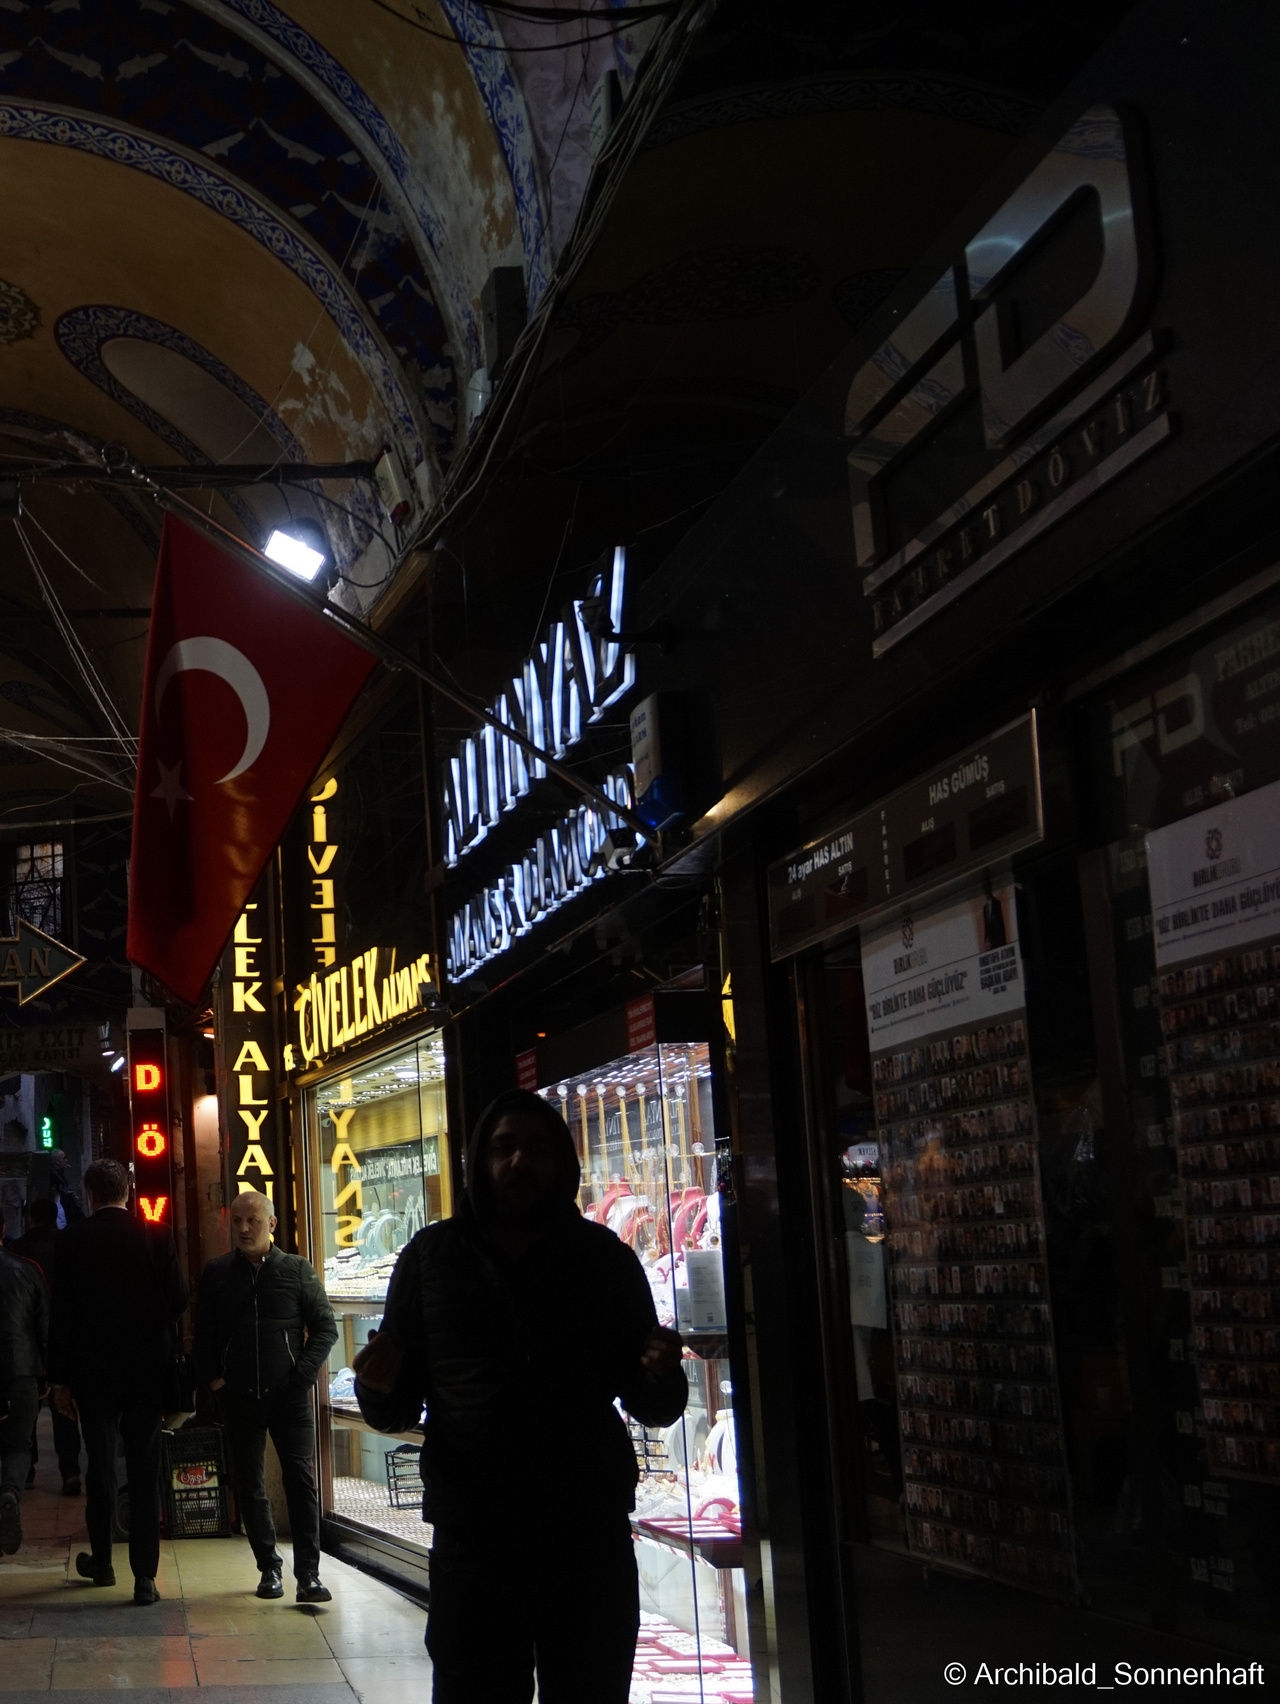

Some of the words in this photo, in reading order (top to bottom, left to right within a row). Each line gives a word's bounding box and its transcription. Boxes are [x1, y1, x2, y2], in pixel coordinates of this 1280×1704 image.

[872, 504, 1000, 631] FAHRET
[1016, 370, 1161, 515] DÖVİZ
[929, 780, 950, 806] HAS
[951, 754, 990, 797] GÜMÜŞ
[788, 864, 797, 885] 24
[797, 859, 813, 881] ayar
[813, 845, 830, 870] HAS
[830, 831, 854, 861] ALTIN
[1212, 896, 1238, 919] DAHA
[300, 946, 382, 1062] ÇİVELEK
[882, 989, 908, 1016] BİRLİKTE
[908, 985, 927, 1007] DAHA
[39, 1027, 88, 1048] EXIT
